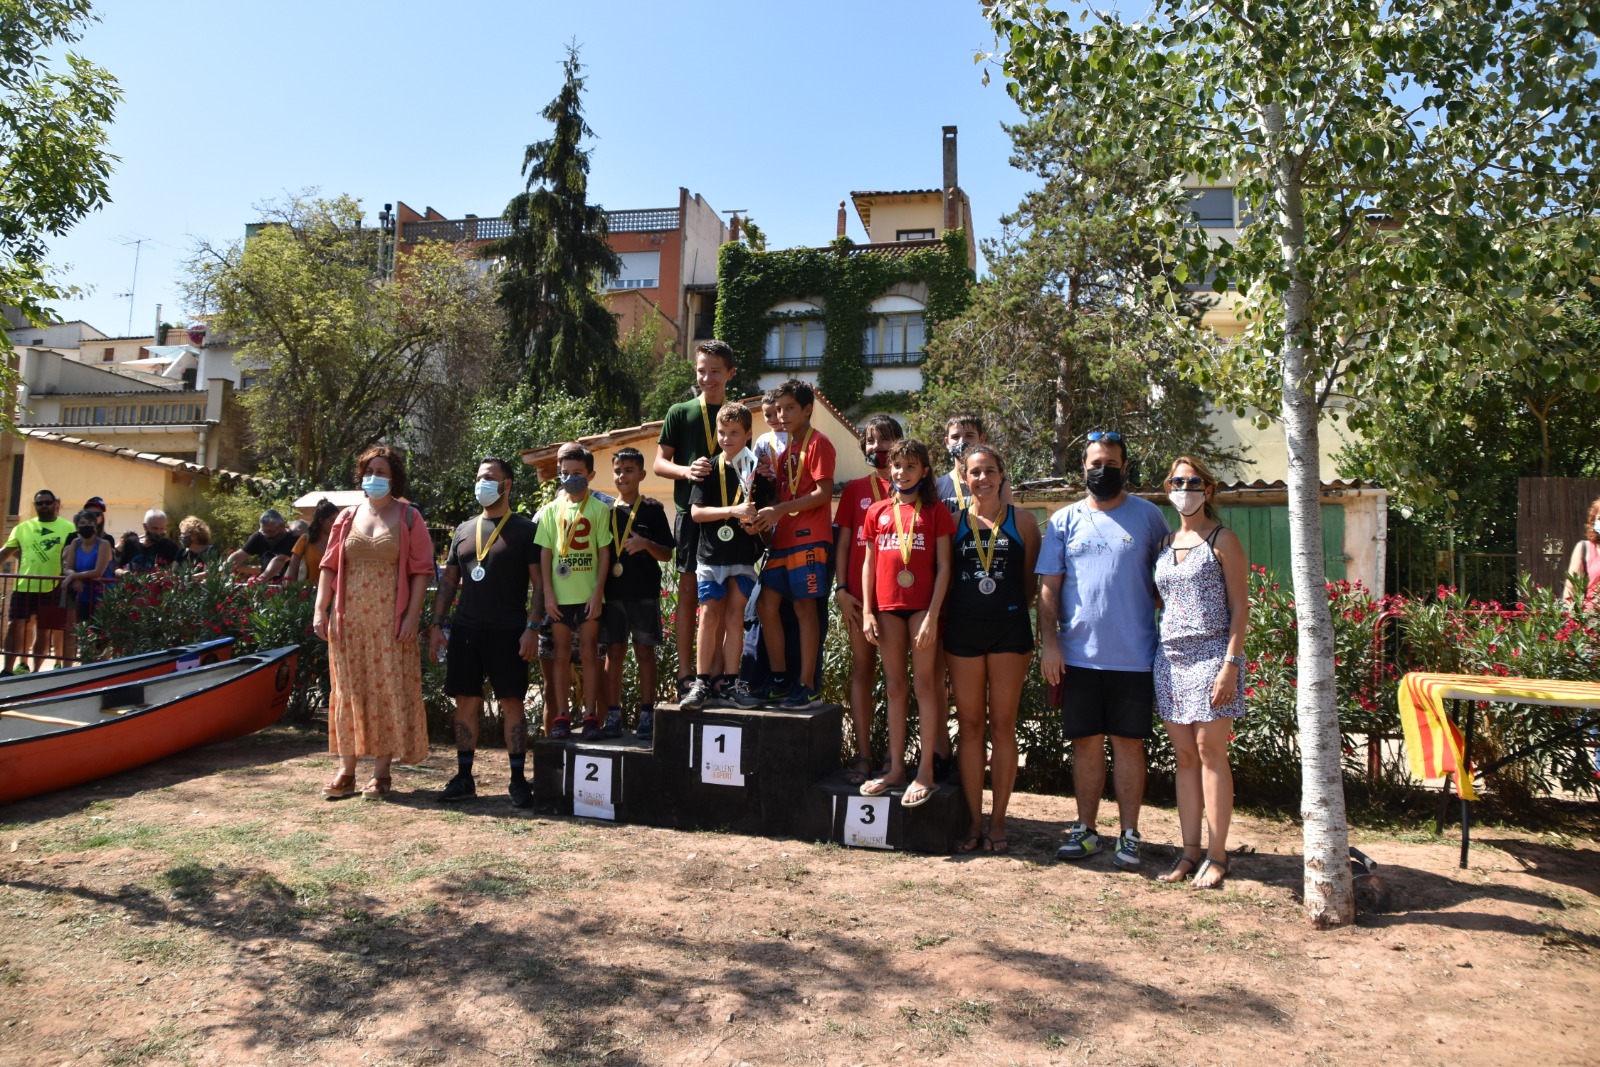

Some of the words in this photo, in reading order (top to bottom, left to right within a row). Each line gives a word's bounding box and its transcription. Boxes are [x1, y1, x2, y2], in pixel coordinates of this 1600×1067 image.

[807, 574, 818, 593] RUN
[714, 734, 726, 753] 1
[585, 763, 599, 781] 2
[713, 765, 735, 773] SALLENT
[713, 772, 733, 780] ESPORT
[860, 804, 875, 824] 3
